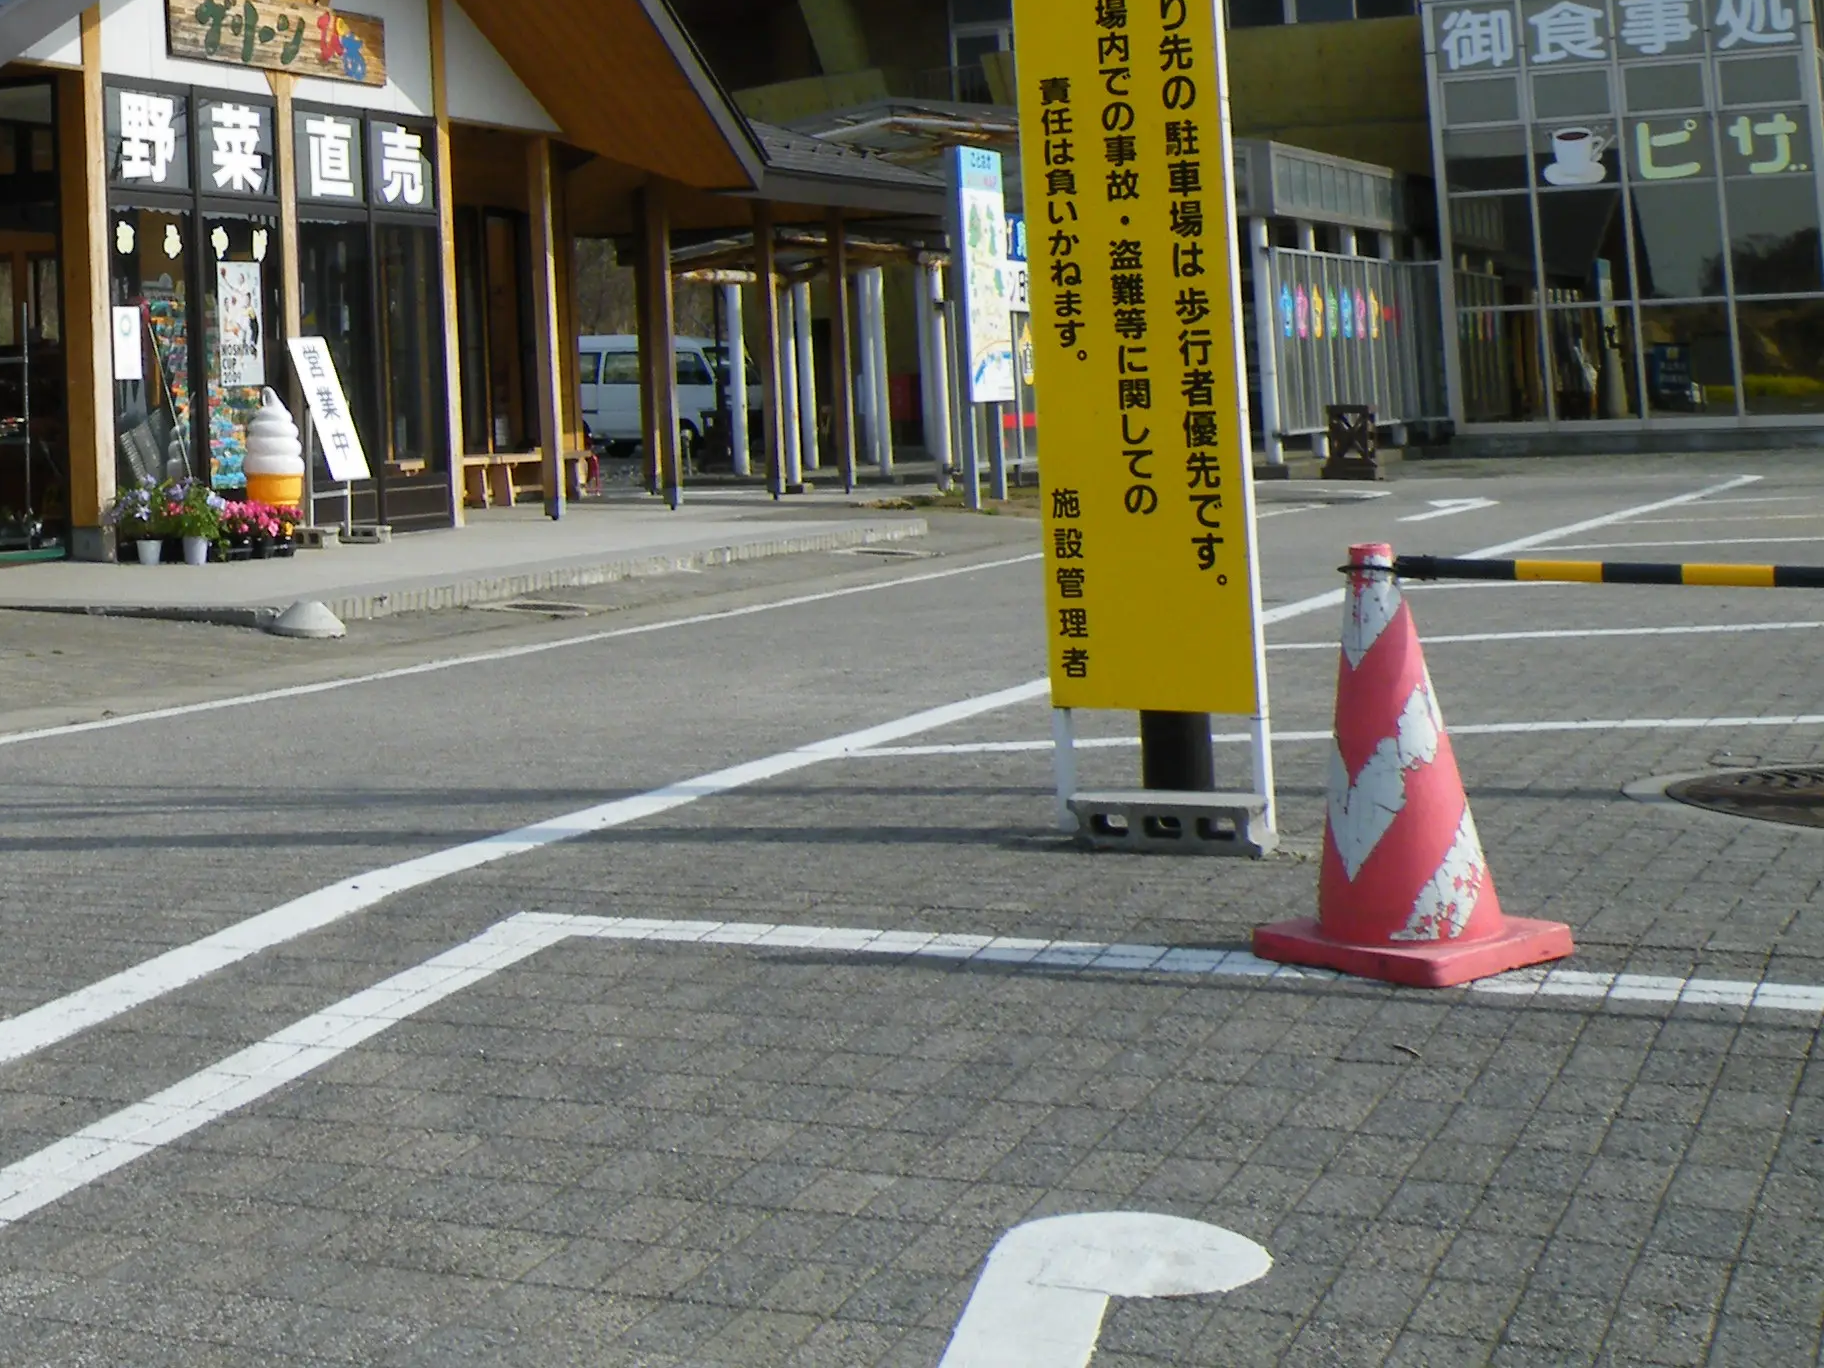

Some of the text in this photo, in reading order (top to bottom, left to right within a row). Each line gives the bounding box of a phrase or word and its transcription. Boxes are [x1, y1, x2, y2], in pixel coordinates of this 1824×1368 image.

[119, 91, 425, 205] 野菜直売
[1636, 113, 1808, 179] ピザ
[1039, 77, 1087, 361] 責任は負いかねます。
[302, 335, 350, 460] 営業中
[1051, 488, 1089, 678] 施設管理者
